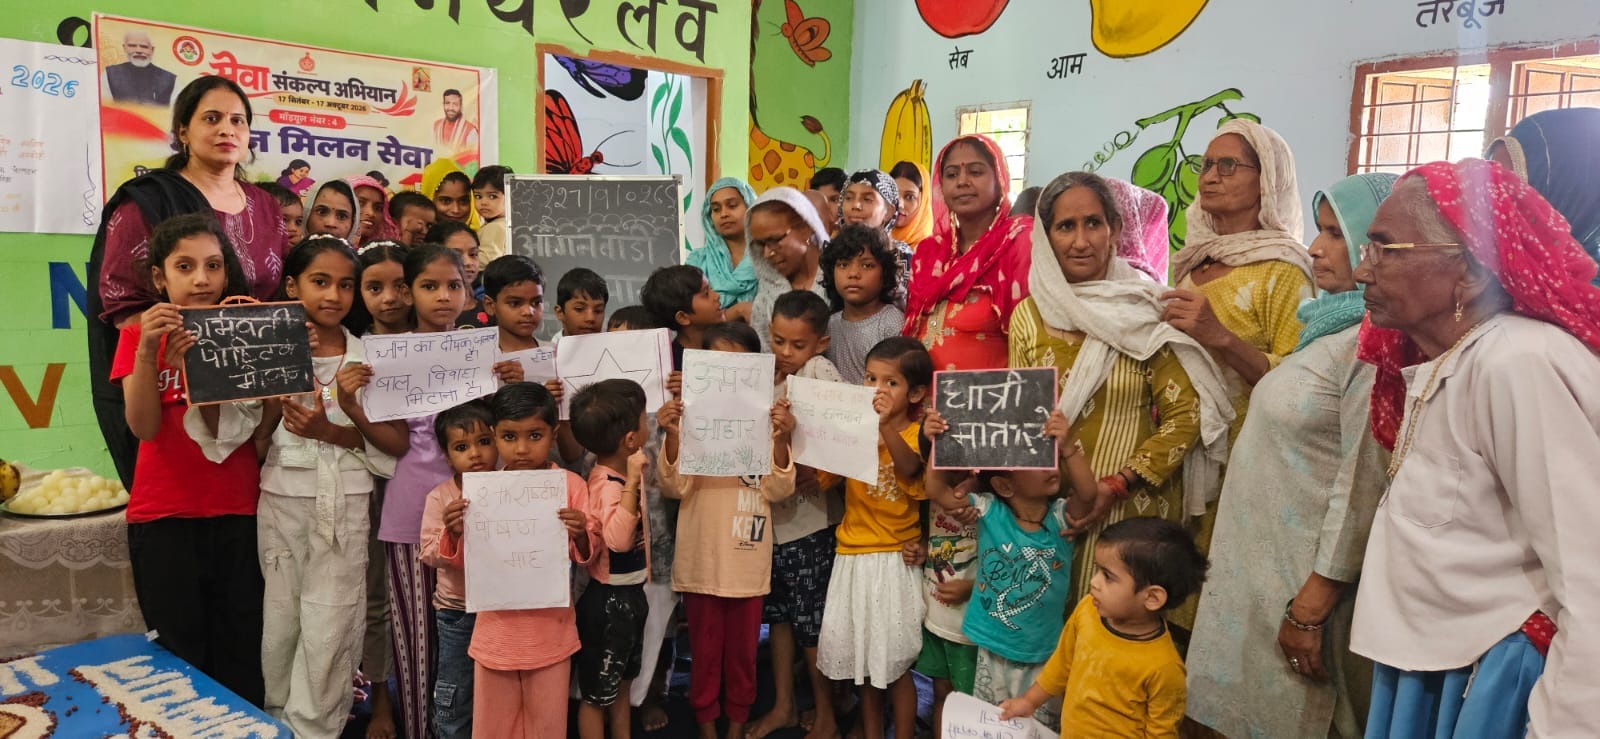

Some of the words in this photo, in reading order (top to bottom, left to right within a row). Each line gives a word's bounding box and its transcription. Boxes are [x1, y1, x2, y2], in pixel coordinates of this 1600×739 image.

[948, 46, 974, 70] सेब
[1046, 53, 1087, 79] आम
[11, 64, 79, 98] 2026
[271, 71, 330, 96] संकल्प
[334, 78, 397, 104] अभियान
[278, 95, 286, 103] 17
[278, 127, 371, 162] मिलन
[377, 135, 434, 168] सेवा
[376, 374, 412, 393] बाल
[731, 515, 766, 541] KEY
[988, 560, 1009, 581] Be
